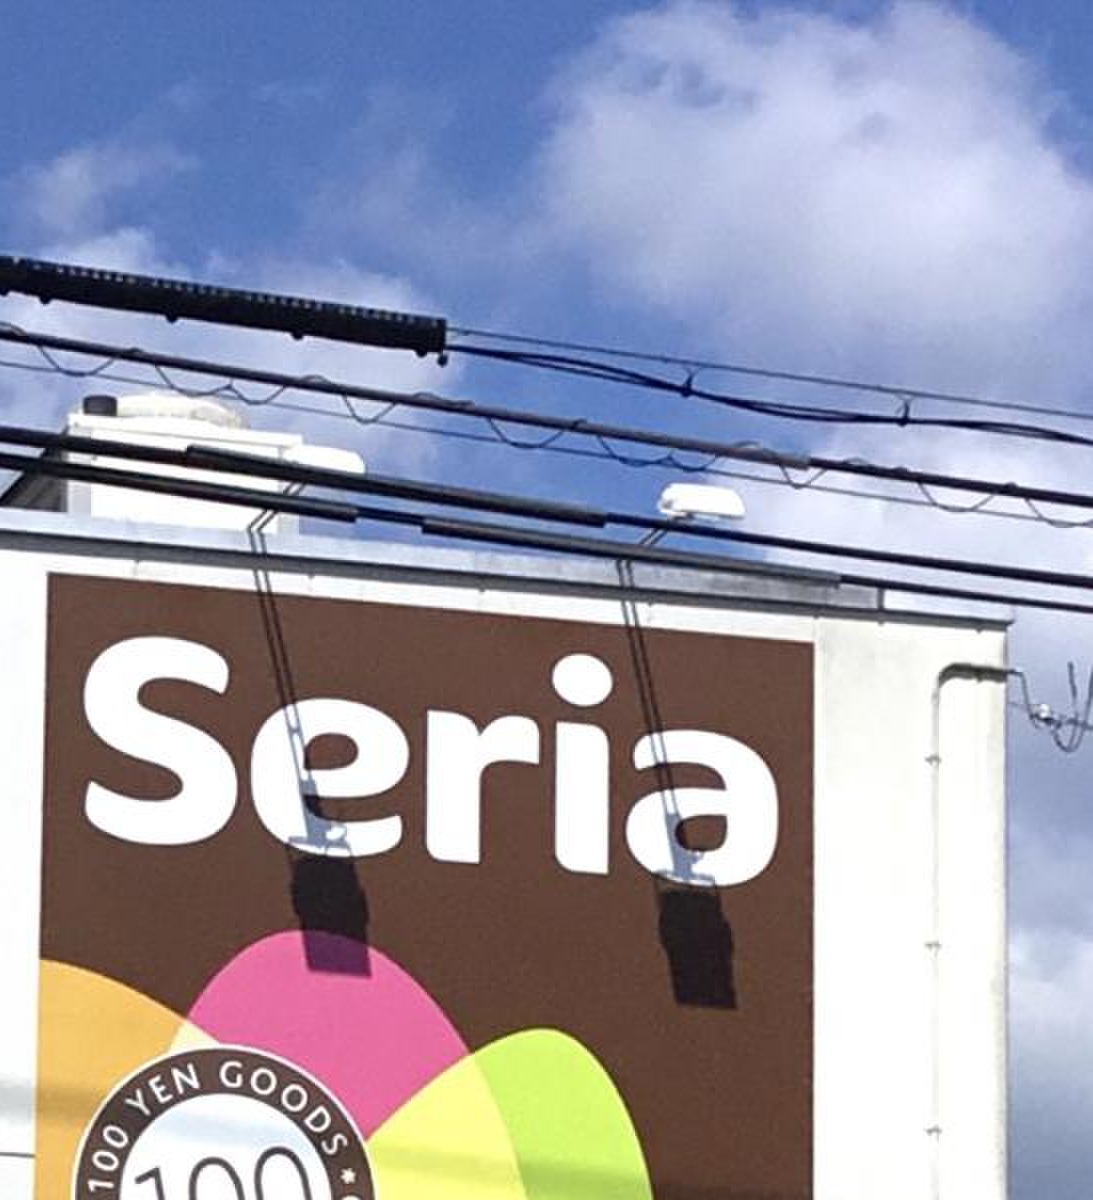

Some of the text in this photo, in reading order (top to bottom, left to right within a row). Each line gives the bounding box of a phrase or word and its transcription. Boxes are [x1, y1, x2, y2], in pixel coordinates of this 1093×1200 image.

[83, 635, 779, 887] Seria
[88, 1061, 348, 1192] 100 YEN GOODS
